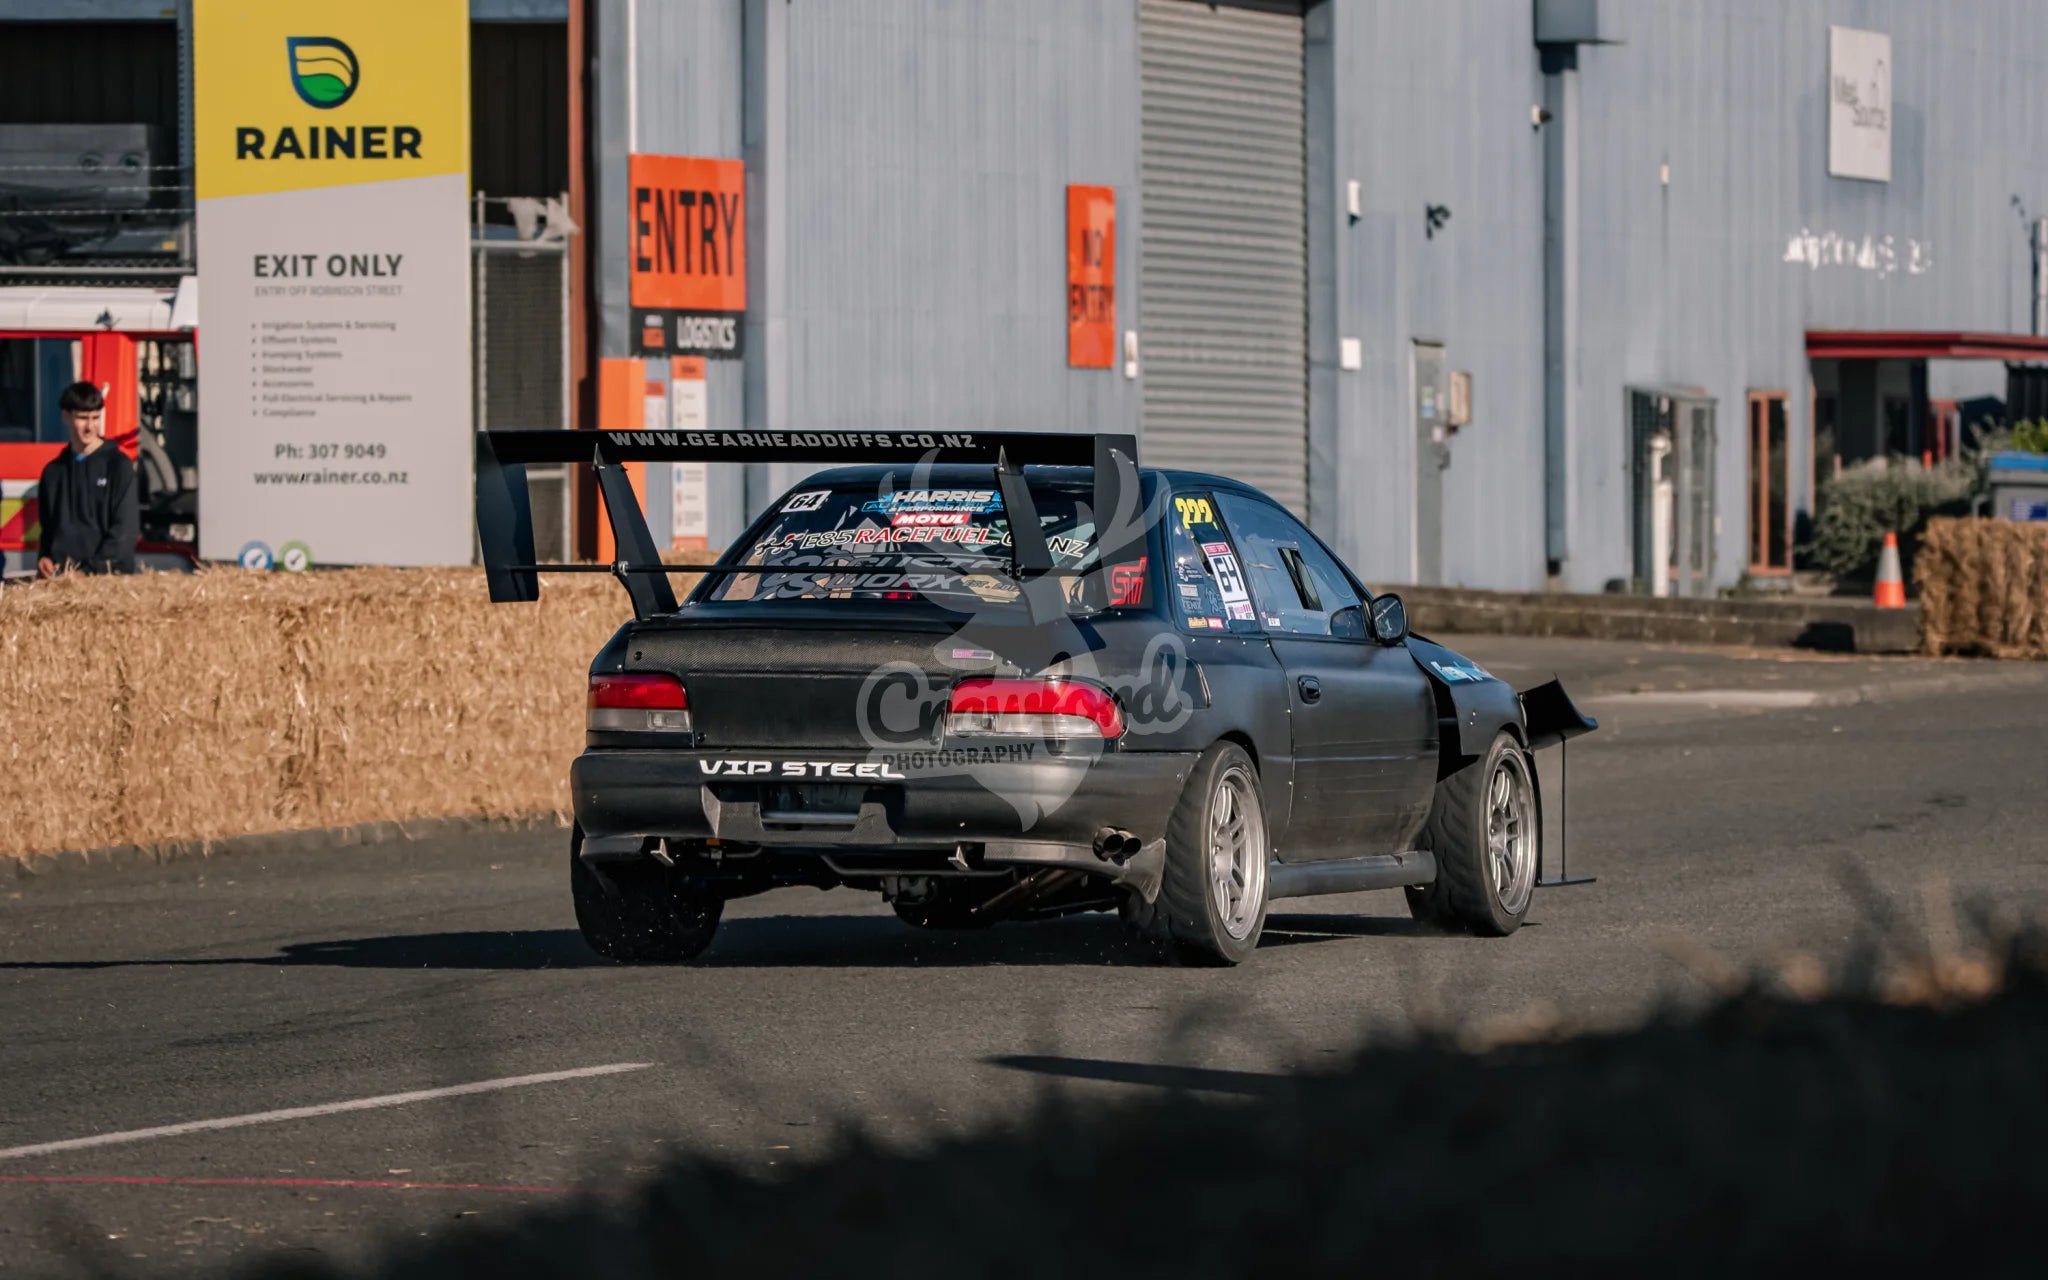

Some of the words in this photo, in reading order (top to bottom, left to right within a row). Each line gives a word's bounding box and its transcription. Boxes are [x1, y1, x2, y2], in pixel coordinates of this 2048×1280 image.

[236, 126, 423, 160] RAINER
[636, 187, 740, 277] ENTRY
[253, 254, 318, 278] EXIT
[326, 254, 404, 278] ONLY
[253, 285, 286, 297] ENTRY
[289, 285, 307, 297] OFF
[310, 285, 363, 297] ROBINSON
[365, 285, 403, 297] STREET
[676, 315, 736, 351] LOGISTICS
[608, 432, 977, 448] WWW.GEARHEADDIFFS.CO.NZ
[274, 443, 304, 460] Ph:
[308, 443, 339, 460] 307
[344, 443, 387, 460] 9049
[253, 468, 409, 485] www.rainer.co.nz
[788, 492, 821, 511] 64
[892, 490, 995, 503] HARRIS
[895, 514, 965, 525] MOTUL
[1213, 556, 1243, 593] 64
[699, 759, 773, 776] VIP
[781, 760, 906, 780] STEEL
